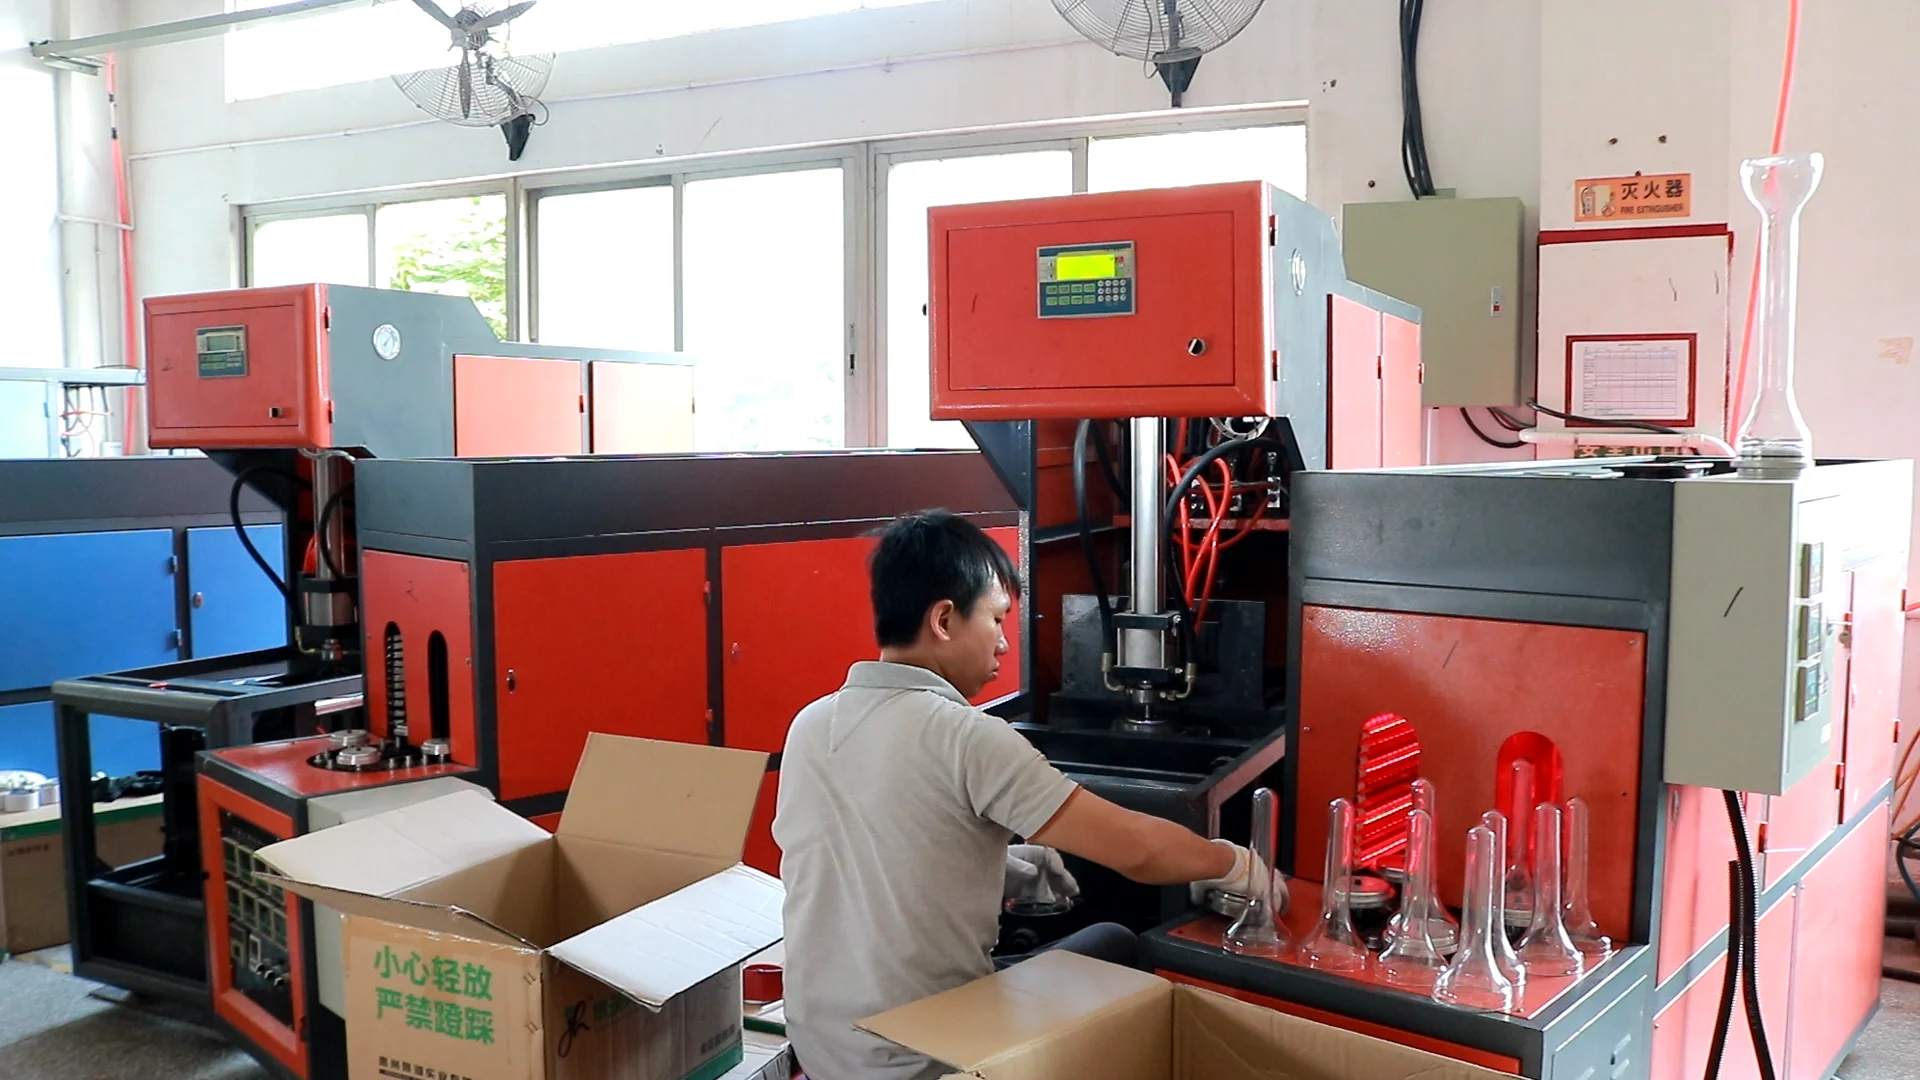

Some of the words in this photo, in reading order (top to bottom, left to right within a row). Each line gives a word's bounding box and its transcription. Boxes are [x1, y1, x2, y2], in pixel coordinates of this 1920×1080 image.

[1620, 179, 1683, 200] 灭火器
[1620, 206, 1634, 214] FIRE
[374, 945, 492, 1001] 小心轻放
[376, 987, 495, 1045] 严禁蹬踩
